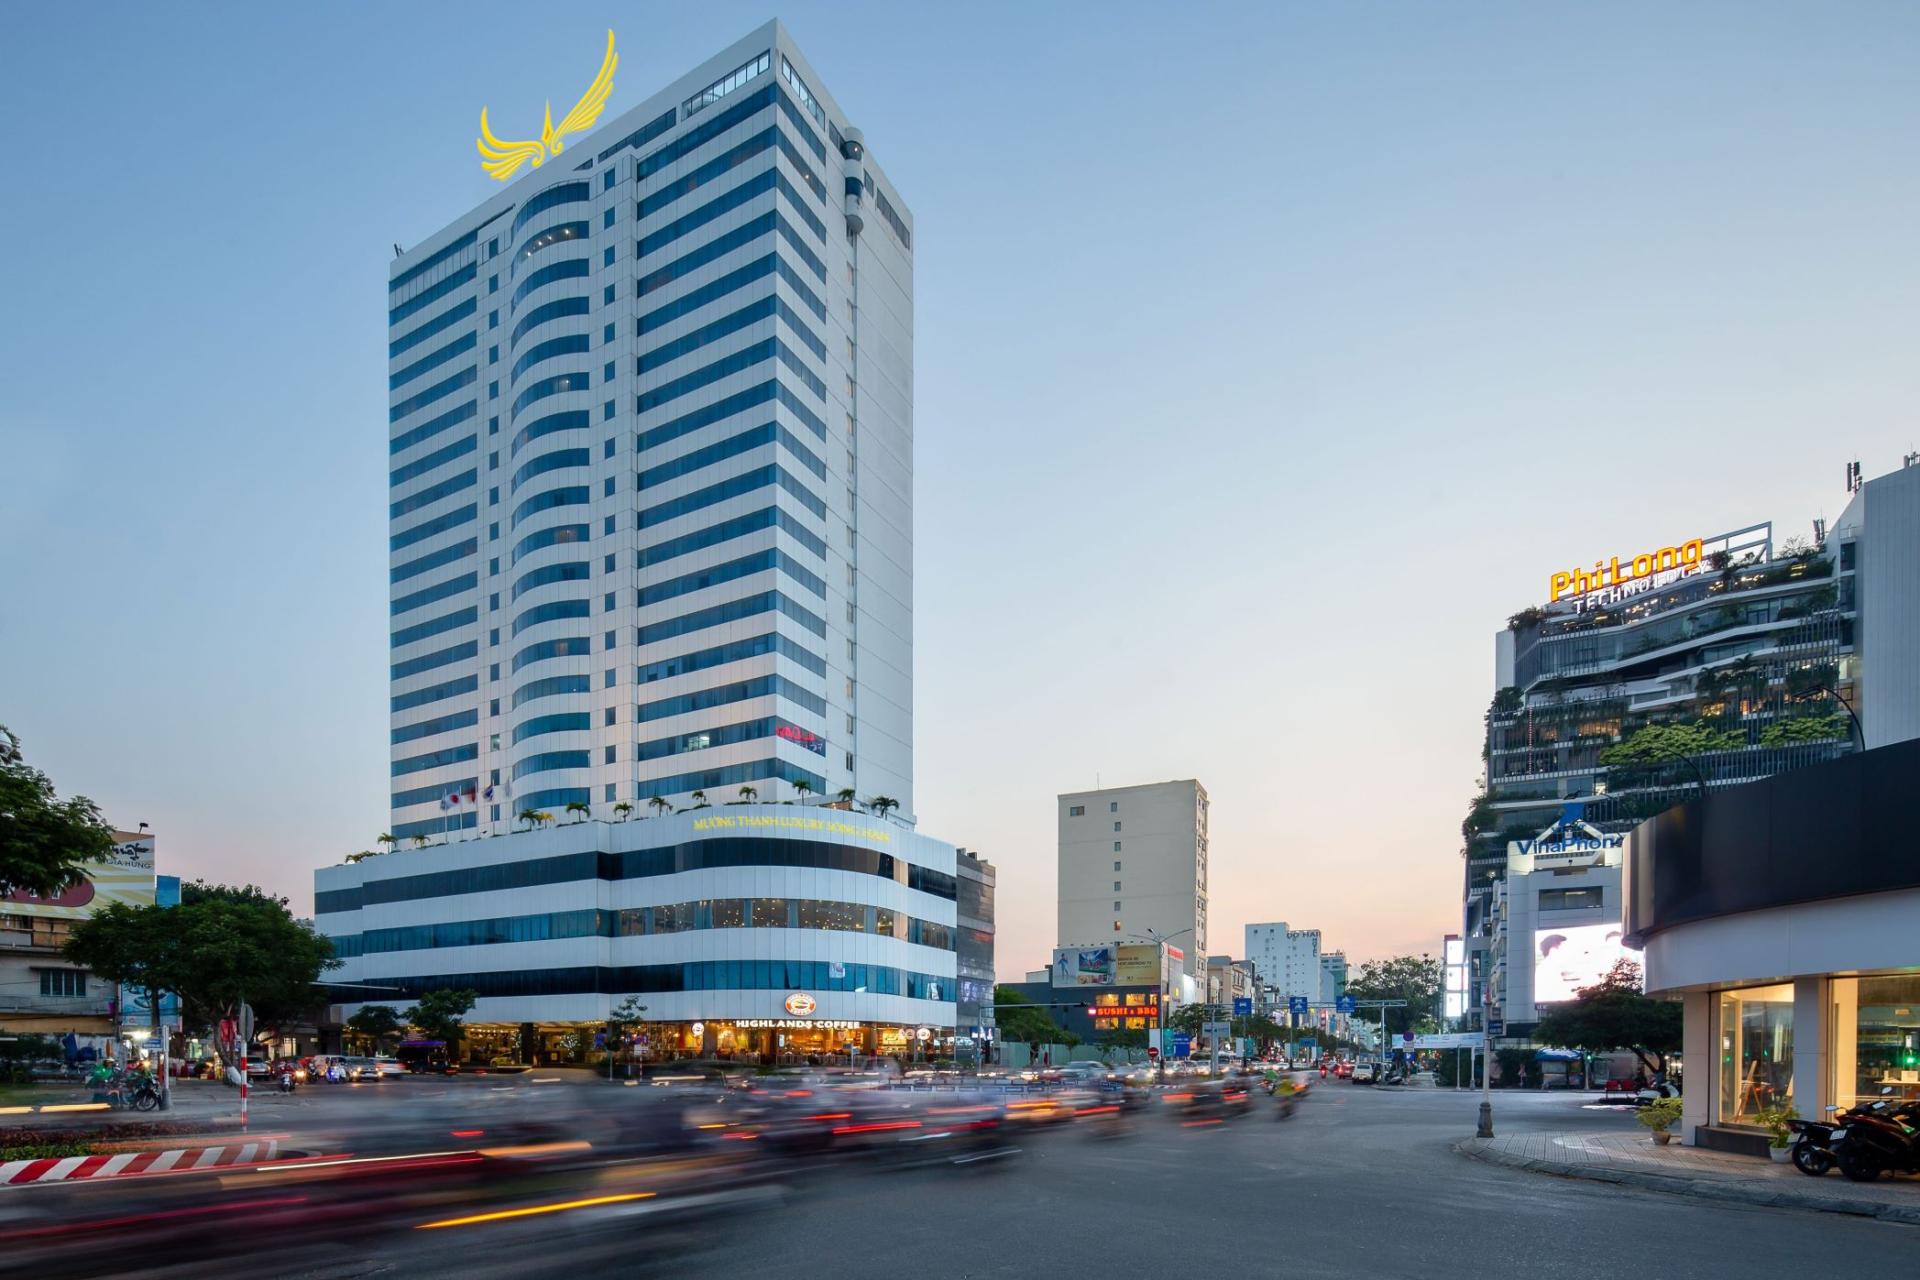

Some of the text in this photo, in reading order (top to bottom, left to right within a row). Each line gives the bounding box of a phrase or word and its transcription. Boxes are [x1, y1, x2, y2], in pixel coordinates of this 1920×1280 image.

[1573, 559, 1709, 614] TECHNOLOGY
[1097, 1007, 1128, 1016] SUSHI
[1137, 1006, 1158, 1016] BBQ
[735, 1019, 860, 1030] HIGHLANDS COFFEE
